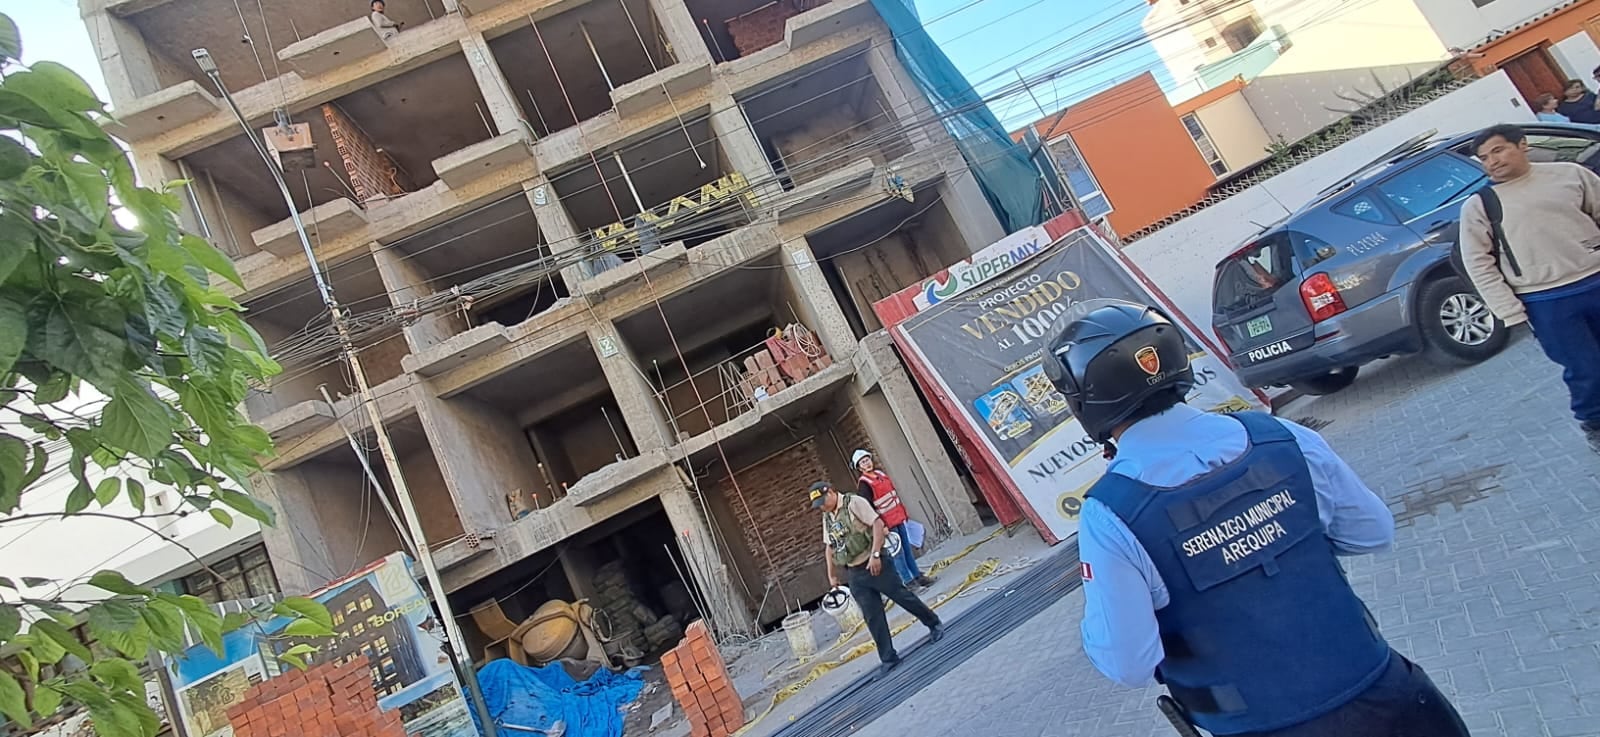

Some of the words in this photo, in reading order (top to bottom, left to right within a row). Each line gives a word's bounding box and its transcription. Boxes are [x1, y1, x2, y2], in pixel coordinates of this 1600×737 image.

[961, 239, 1041, 286] SUPERMIX
[960, 270, 1081, 340] VENDIDO
[978, 273, 1042, 311] PROYECTO
[997, 336, 1016, 352] AL
[1248, 340, 1293, 363] POLICIA
[1027, 435, 1098, 484] NUEVOS
[1182, 515, 1247, 558] SERENAZGO
[1243, 489, 1297, 529] MUNICIPAL
[1221, 519, 1288, 566] AREQUIPA
